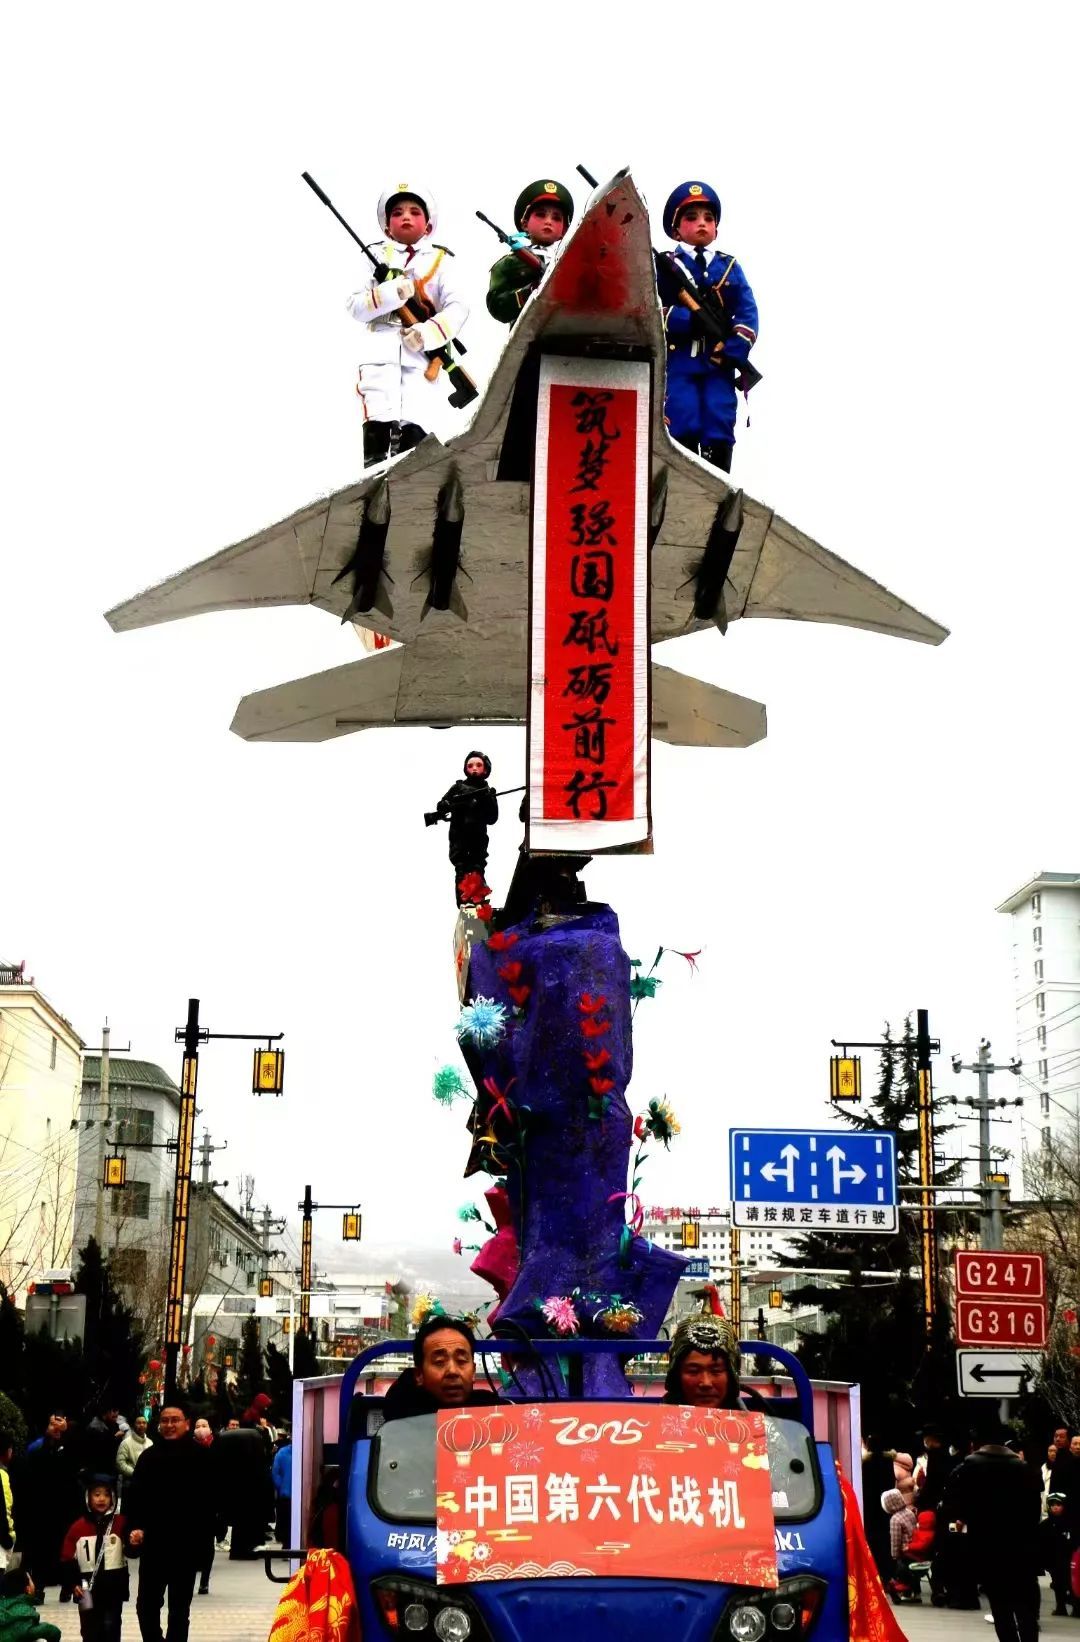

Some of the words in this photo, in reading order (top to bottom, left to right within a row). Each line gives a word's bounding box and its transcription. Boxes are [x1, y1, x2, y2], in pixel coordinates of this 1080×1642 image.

[562, 391, 621, 820] 筑梦强国砥砺前行
[746, 1206, 886, 1225] 请按规定车道行驶
[966, 1261, 1032, 1287] G247
[968, 1308, 1035, 1336] G316
[549, 1416, 650, 1445] 2025
[464, 1472, 746, 1529] 中国第六代战机
[83, 1539, 91, 1562] 1
